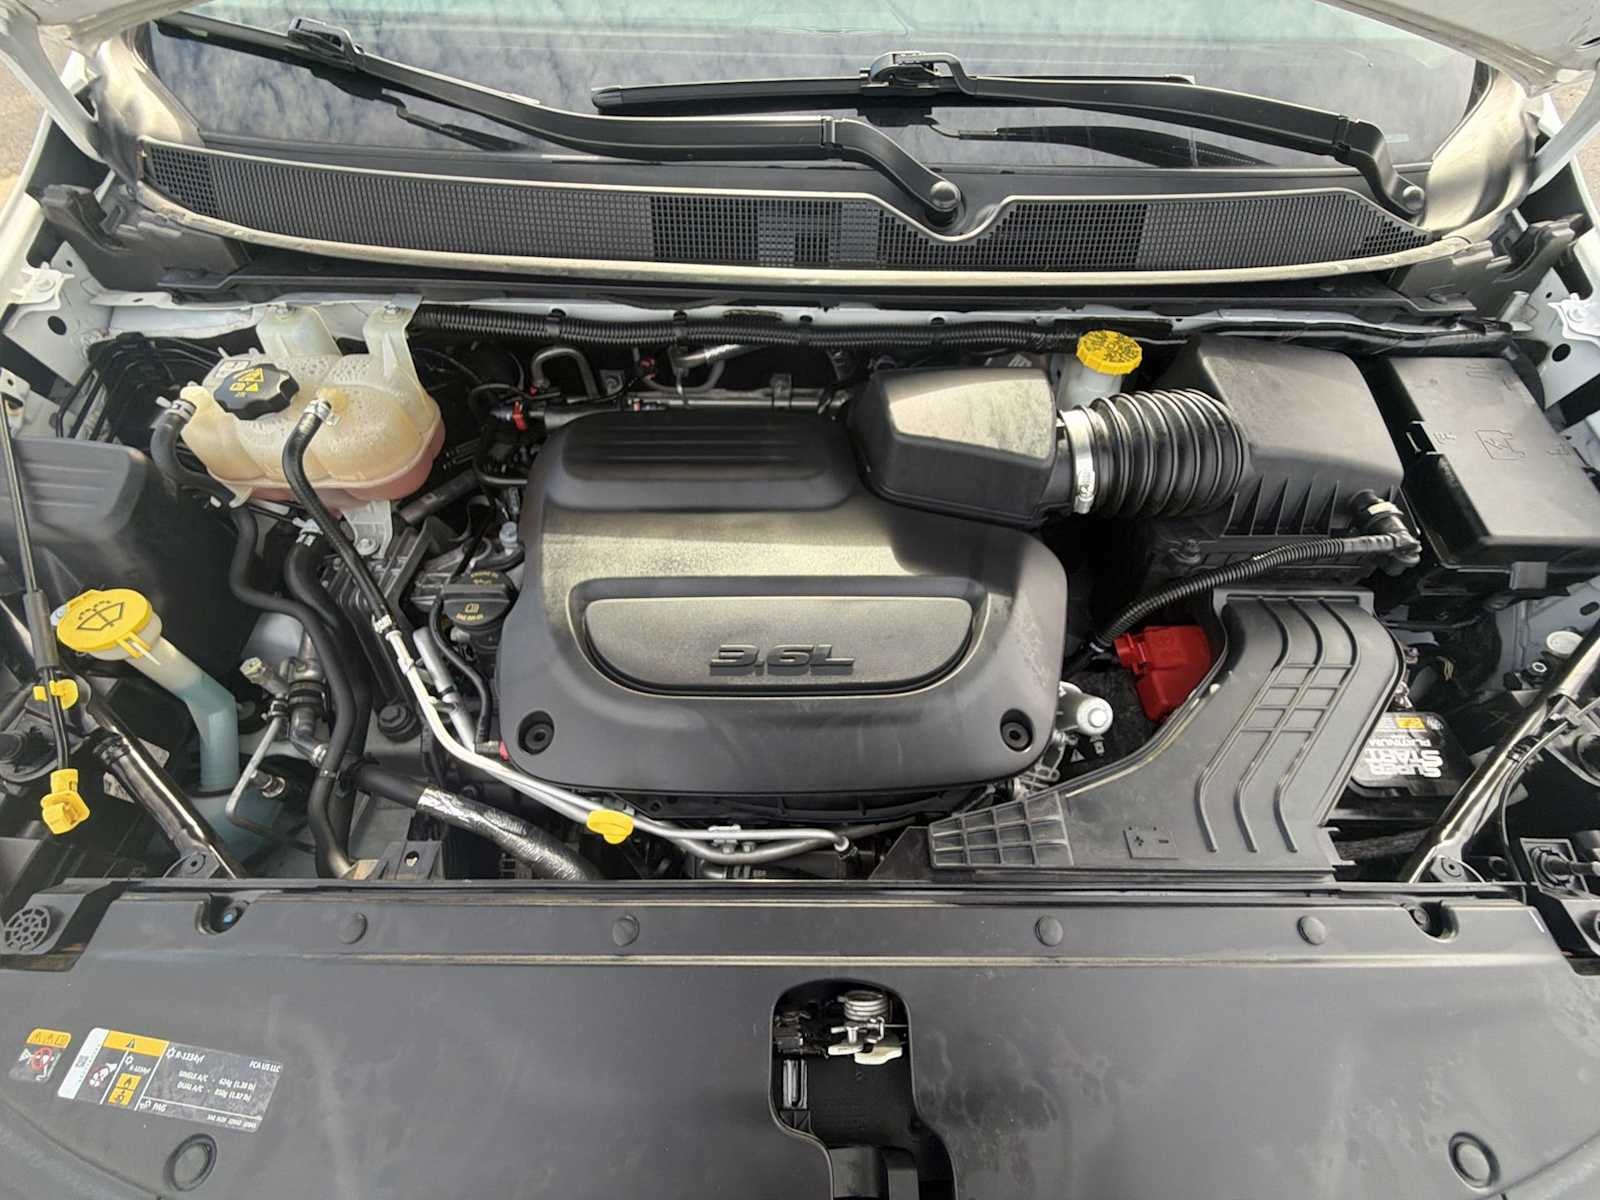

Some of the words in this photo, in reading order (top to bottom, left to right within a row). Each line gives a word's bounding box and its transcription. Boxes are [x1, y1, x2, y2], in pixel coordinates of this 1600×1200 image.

[709, 643, 855, 676] 3.6L
[1364, 749, 1443, 767] START
[1369, 763, 1442, 778] SUPER
